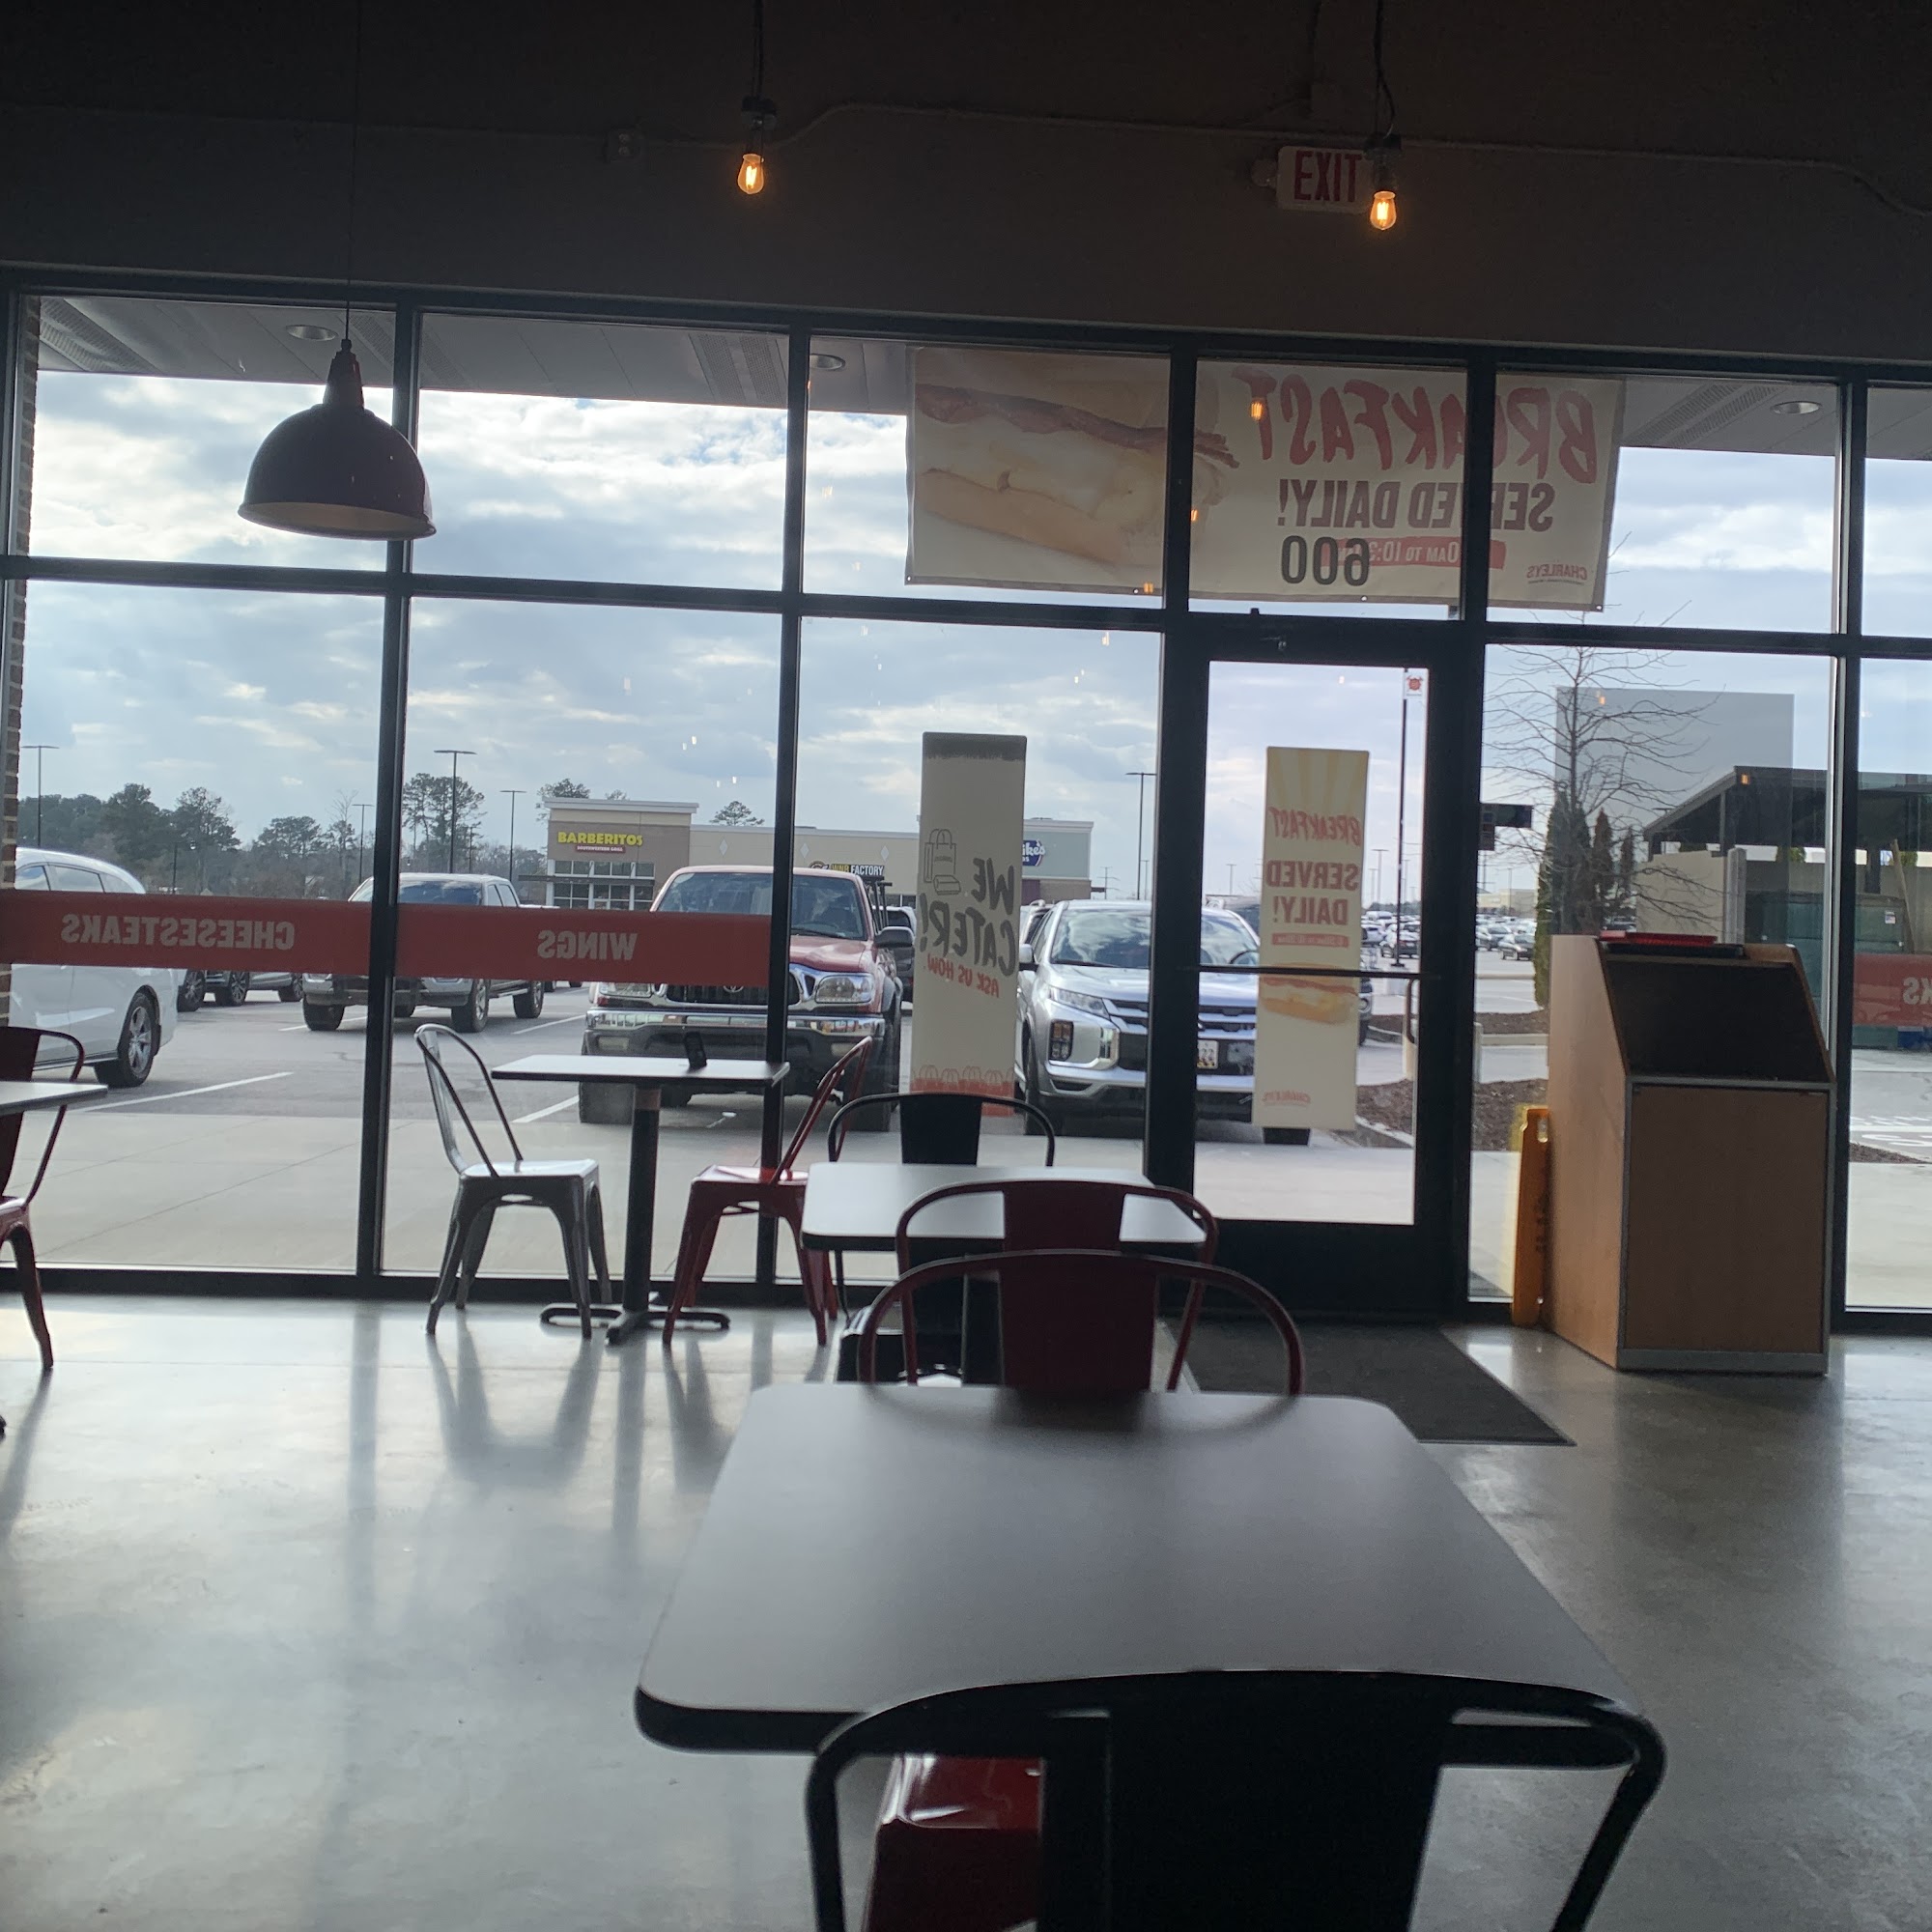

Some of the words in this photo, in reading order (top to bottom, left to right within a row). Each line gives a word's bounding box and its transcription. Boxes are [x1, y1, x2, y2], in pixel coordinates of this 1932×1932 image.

[1294, 151, 1362, 202] EXIT
[557, 831, 643, 846] BARBERITOS
[851, 865, 884, 876] FACTORY
